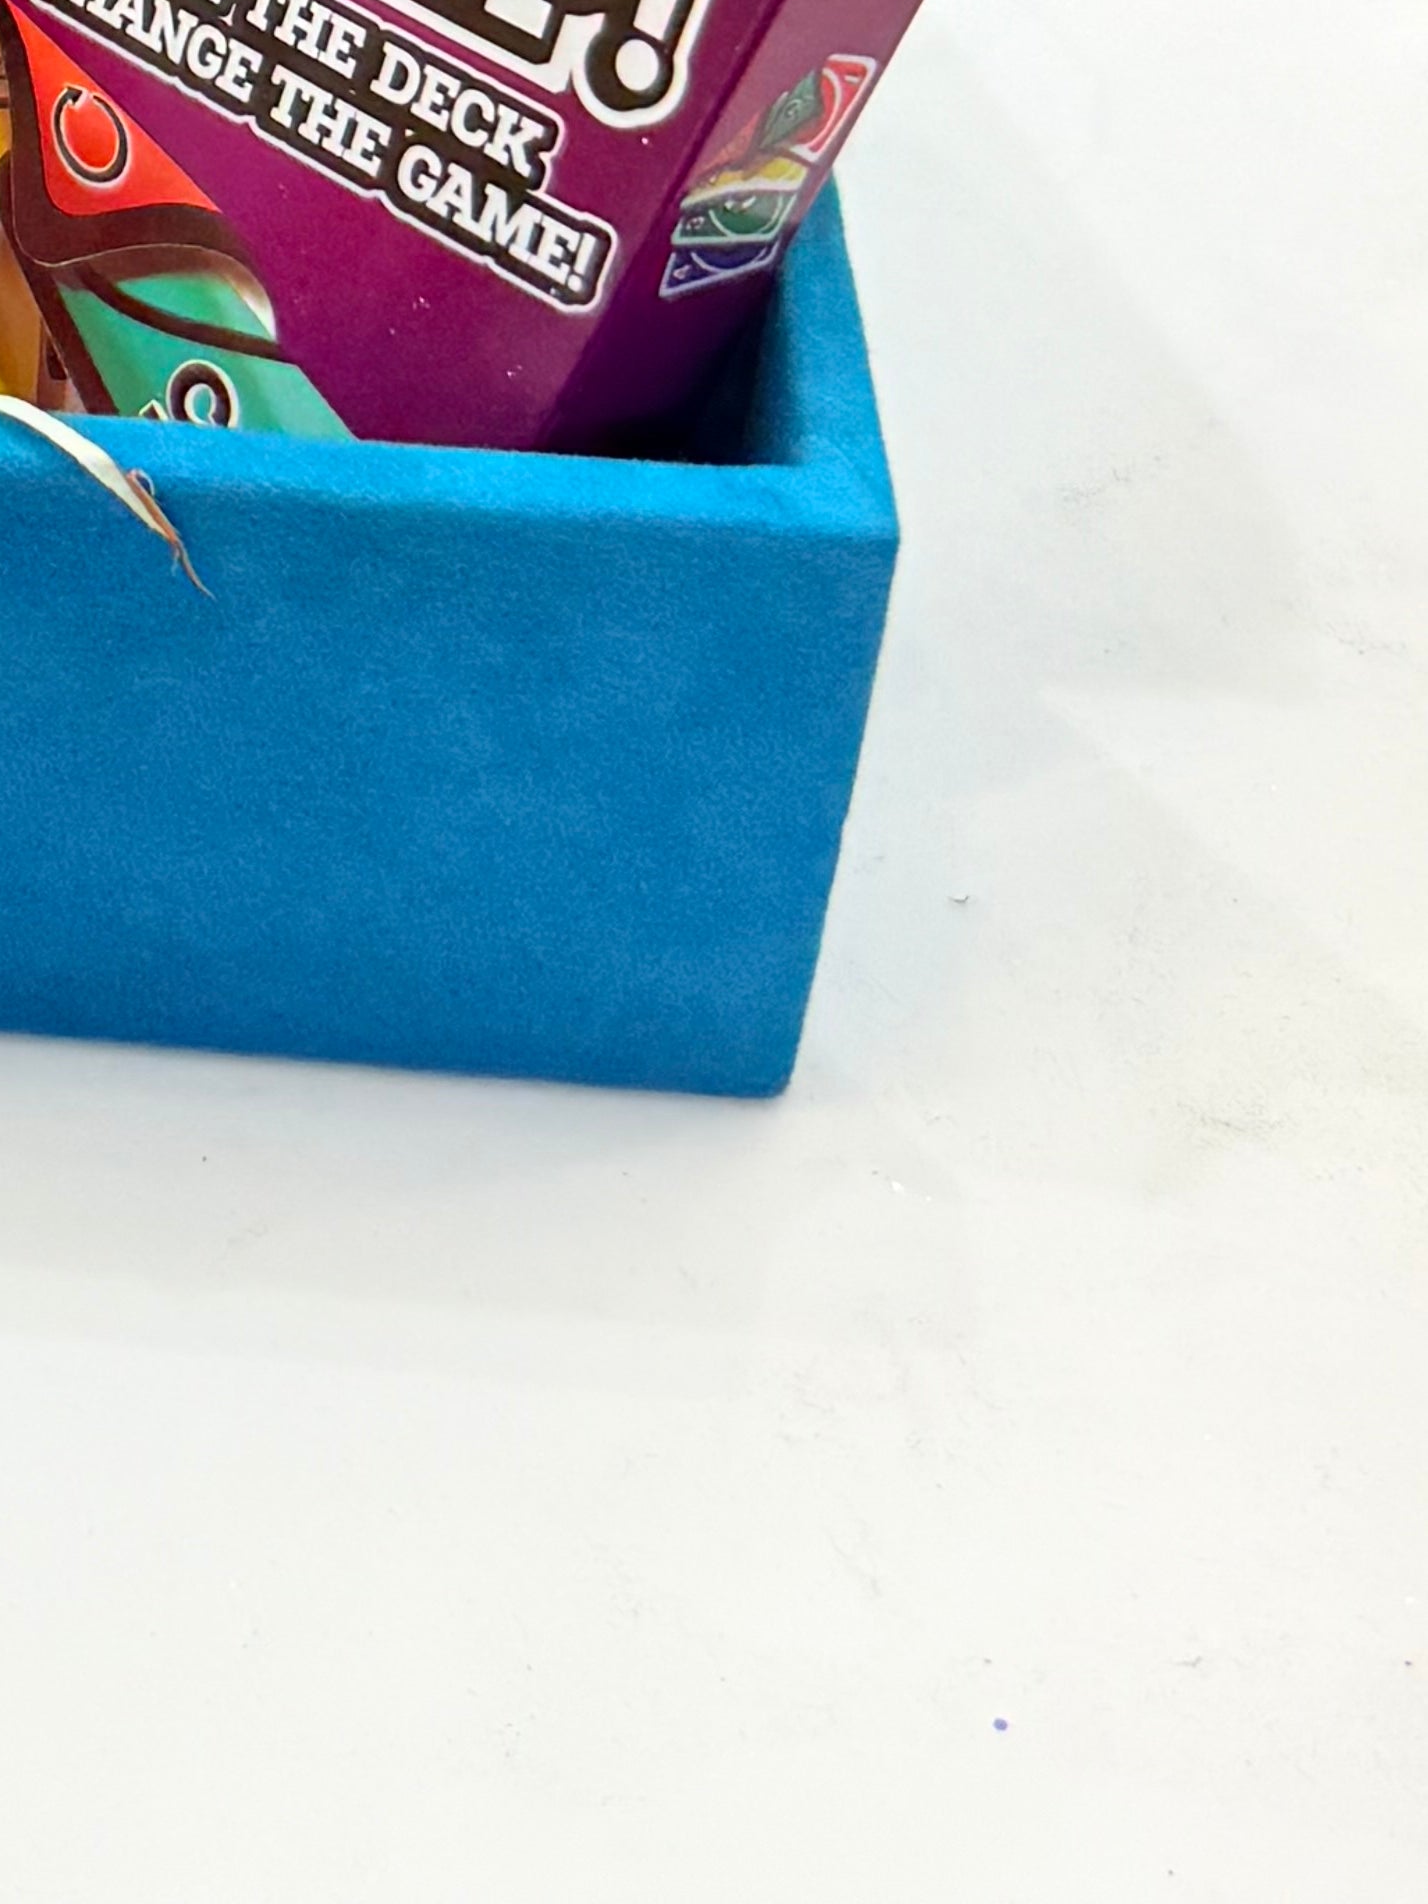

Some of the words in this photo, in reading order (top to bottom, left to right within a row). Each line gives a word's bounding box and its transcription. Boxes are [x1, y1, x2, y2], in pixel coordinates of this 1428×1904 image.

[270, 63, 390, 177] THE
[397, 143, 595, 292] GAME!
[371, 41, 545, 177] DECK
